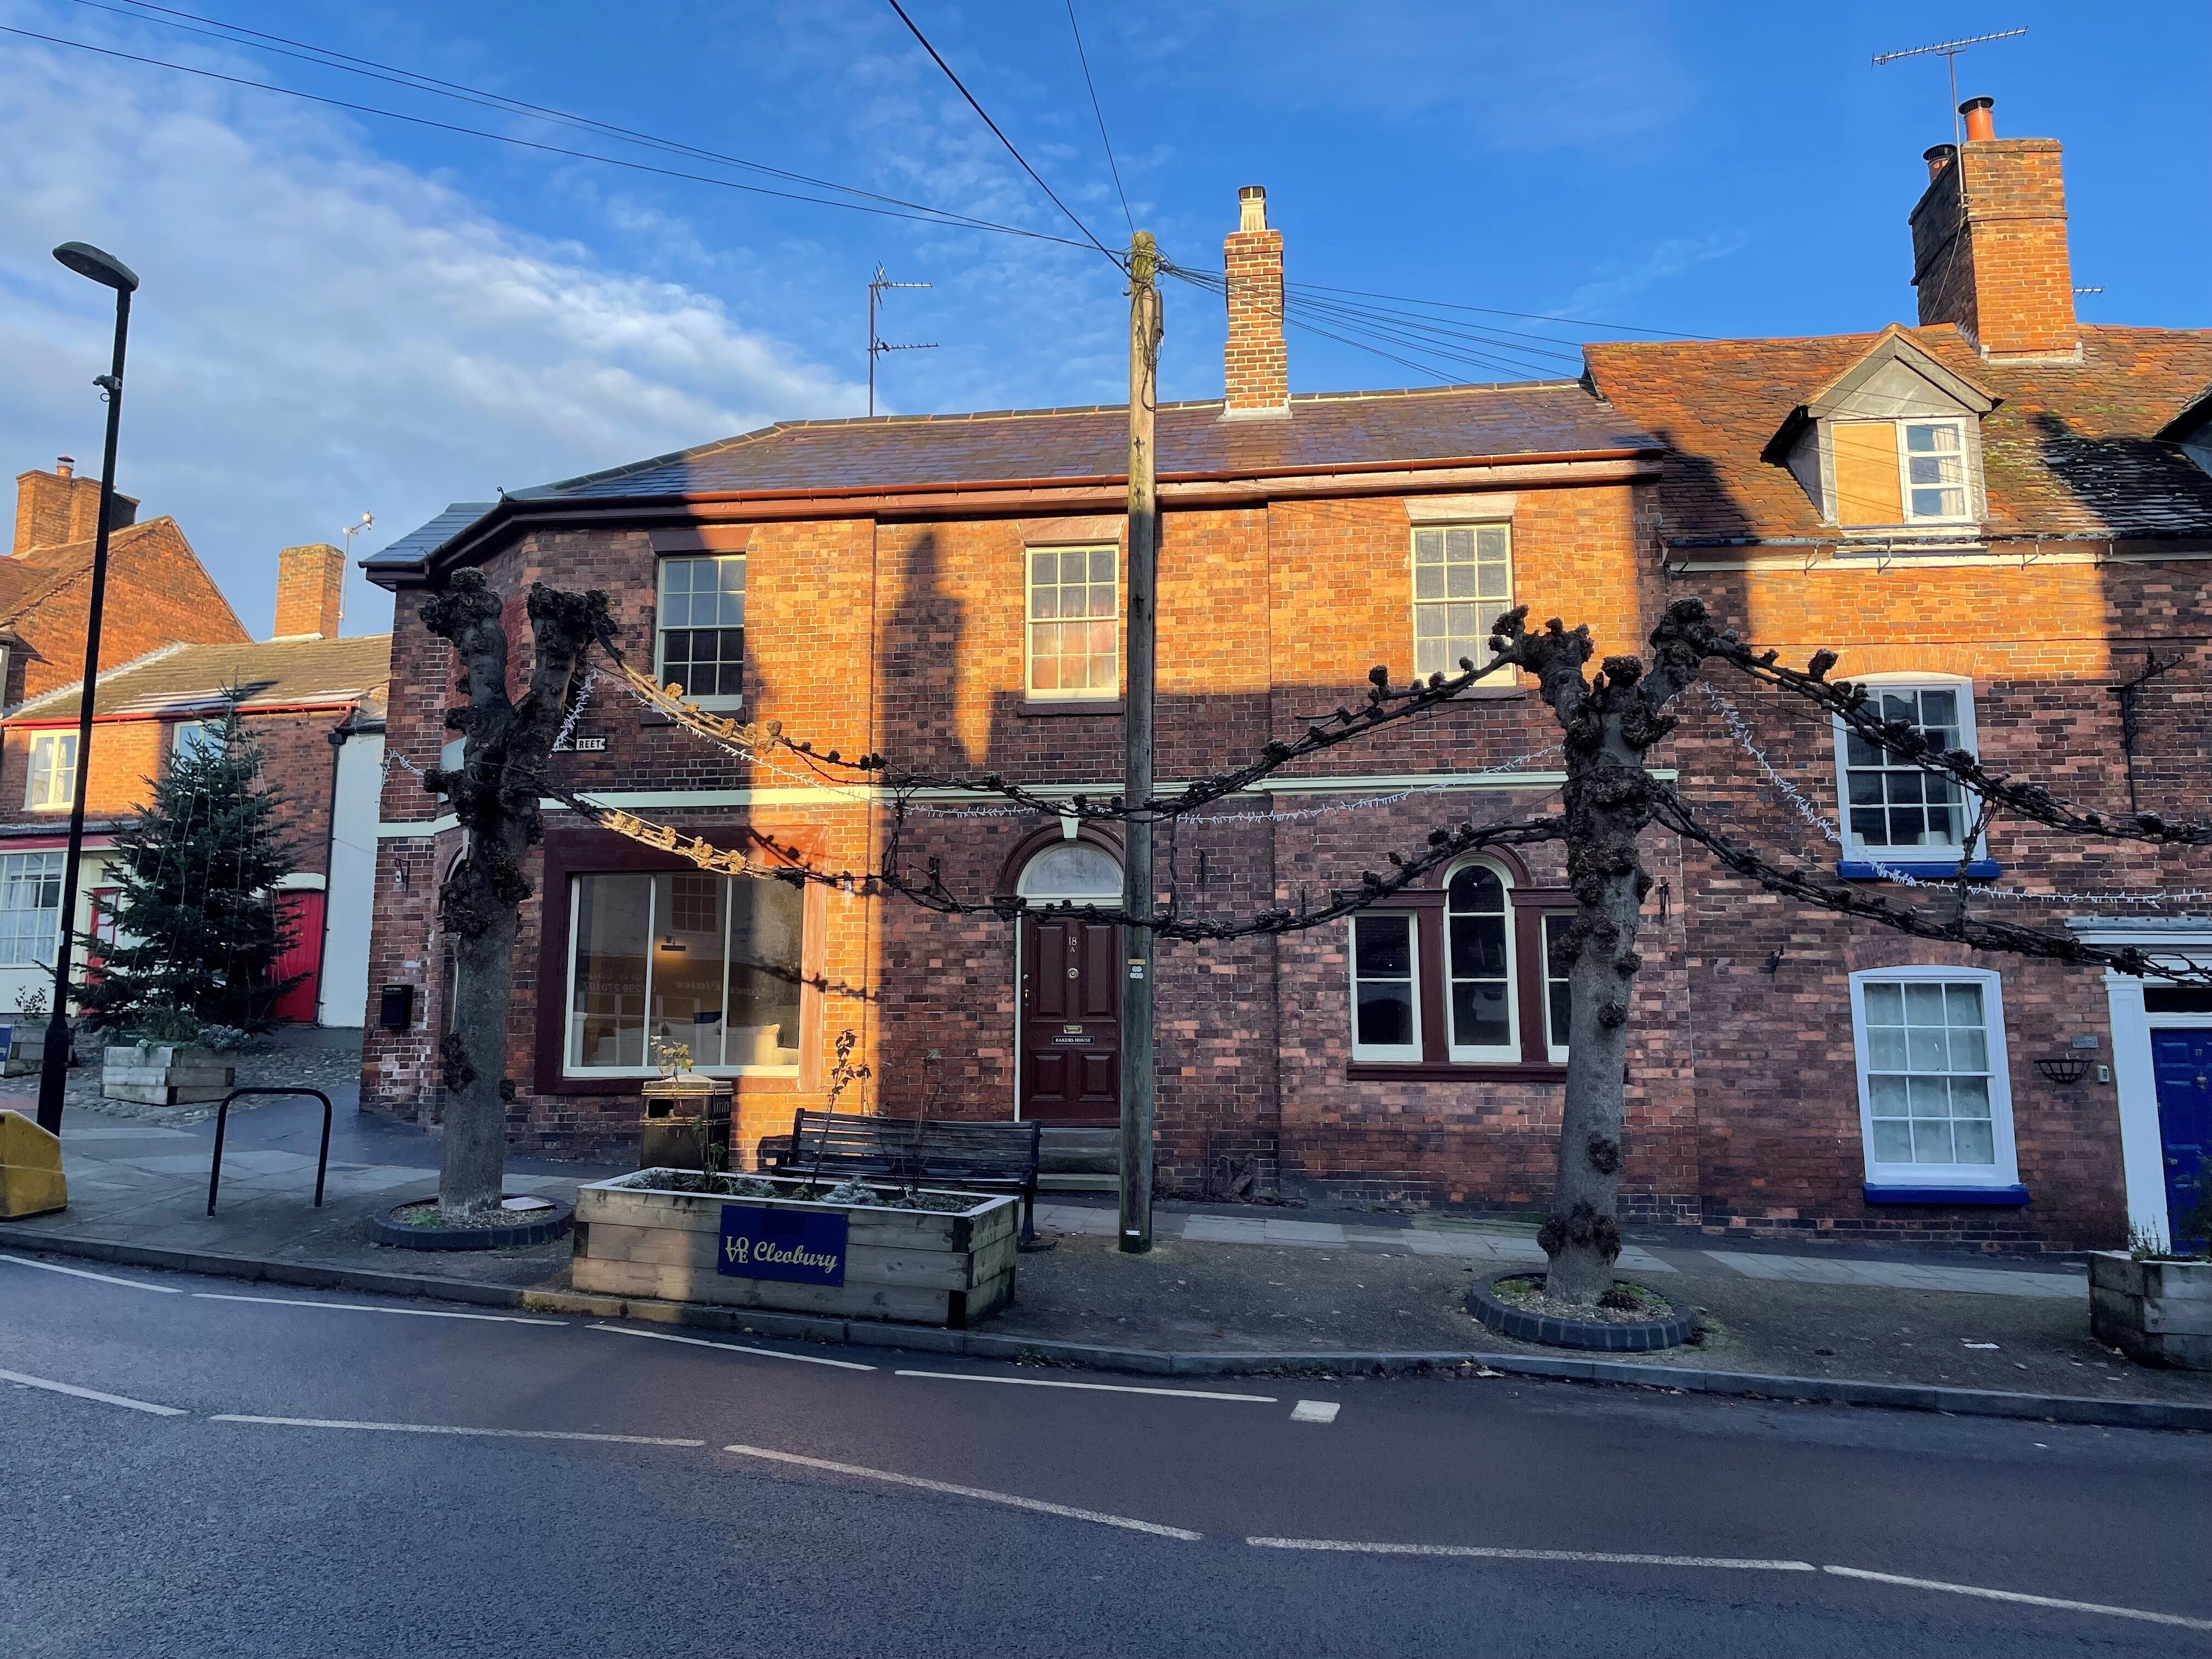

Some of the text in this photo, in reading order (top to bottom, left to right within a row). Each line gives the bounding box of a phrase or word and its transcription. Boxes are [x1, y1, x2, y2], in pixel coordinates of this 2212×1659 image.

[579, 740, 601, 749] REET
[1069, 936, 1077, 946] 18
[753, 1242, 838, 1273] Cleobury
